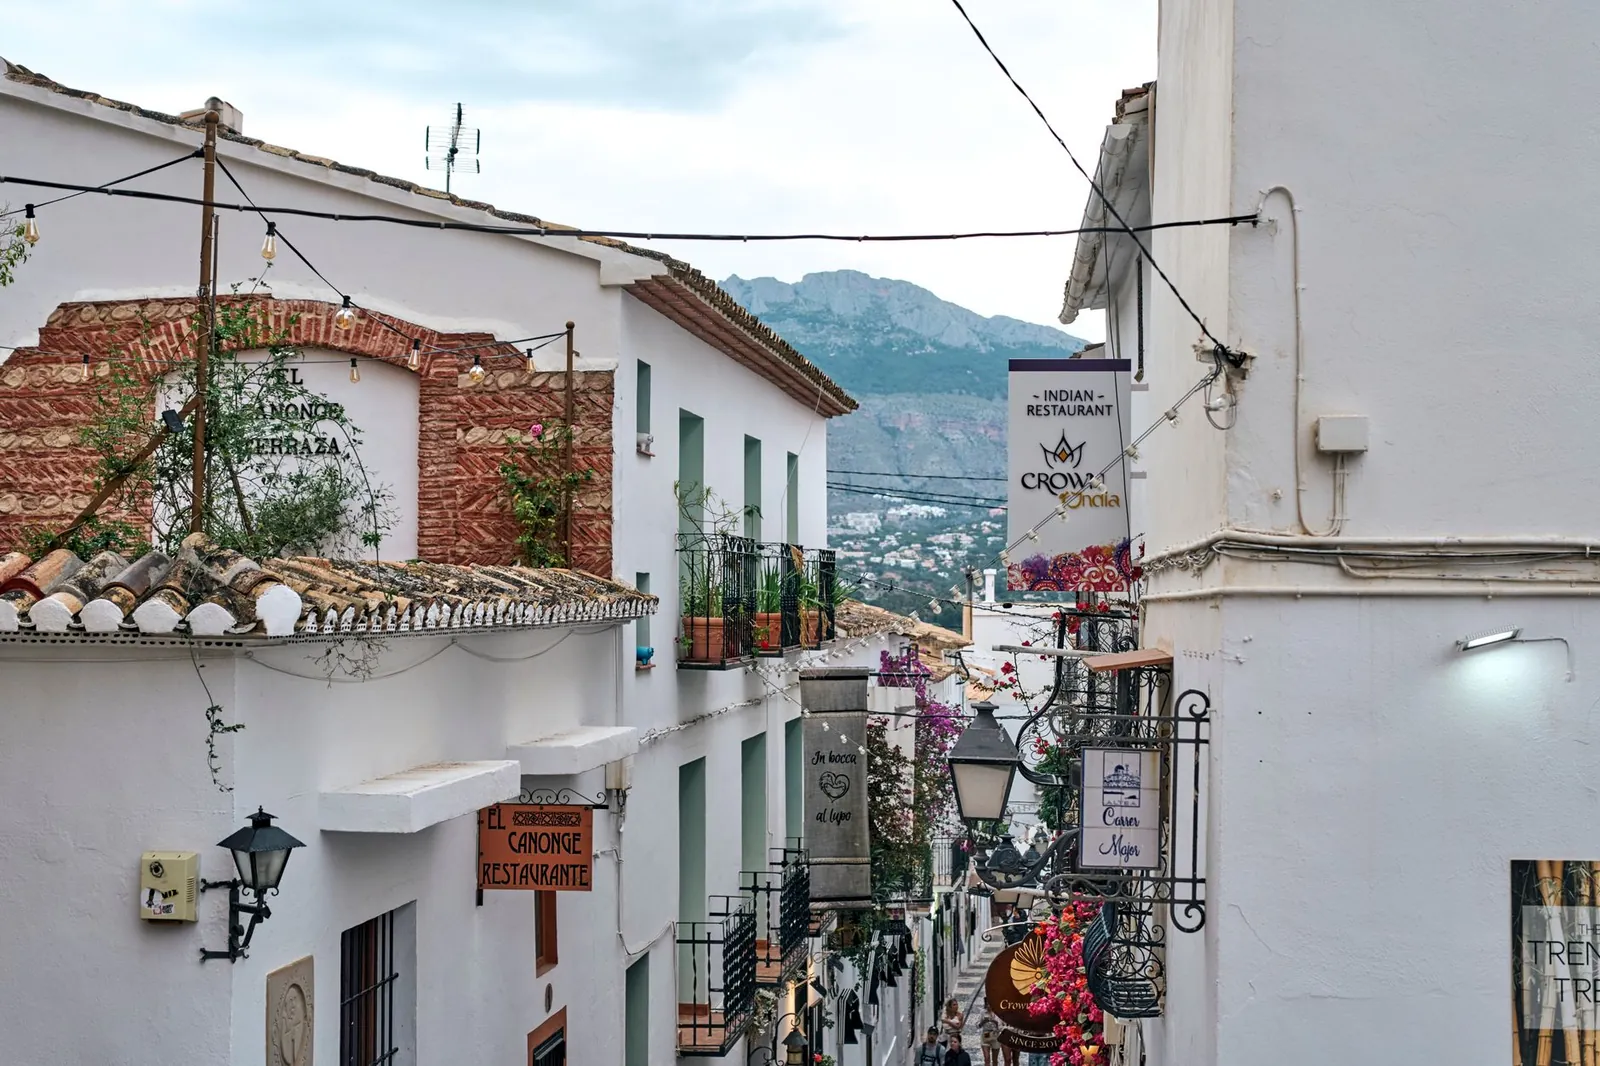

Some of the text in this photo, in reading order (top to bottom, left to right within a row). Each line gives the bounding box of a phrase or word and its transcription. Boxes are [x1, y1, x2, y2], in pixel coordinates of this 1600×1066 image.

[1044, 390, 1094, 402] INDIAN
[1027, 404, 1113, 416] RESTAURANT
[241, 437, 341, 455] ERRAZA
[829, 751, 857, 764] bocca
[487, 808, 506, 830] EL
[816, 808, 852, 826] al lupo
[1102, 806, 1140, 827] Carrer
[508, 831, 582, 855] CANONGE
[1099, 833, 1141, 863] Major
[1009, 1035, 1038, 1048] SINCE
